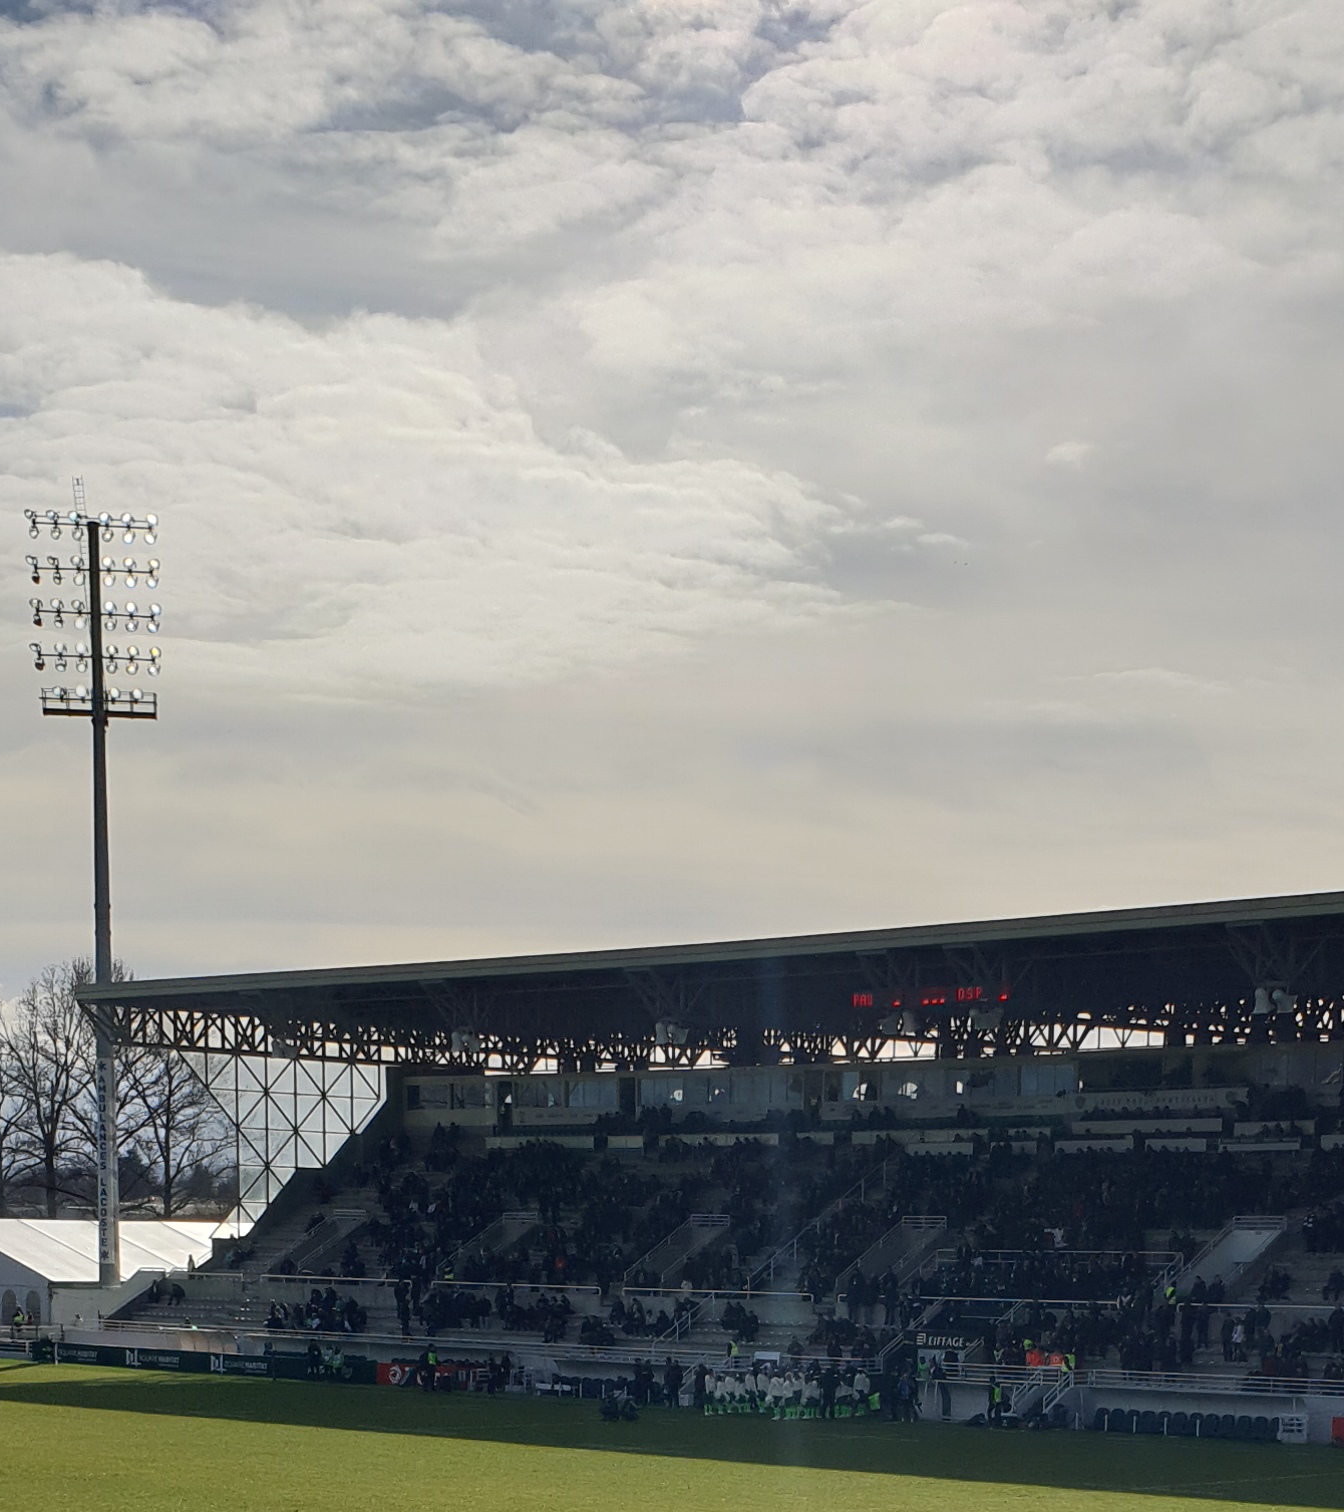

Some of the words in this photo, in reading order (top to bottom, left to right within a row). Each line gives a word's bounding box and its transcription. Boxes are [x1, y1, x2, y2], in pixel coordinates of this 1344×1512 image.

[98, 1075, 108, 1170] AMBULANCES
[100, 1177, 109, 1246] LACOSTE
[928, 1335, 965, 1347] EIFFAGE
